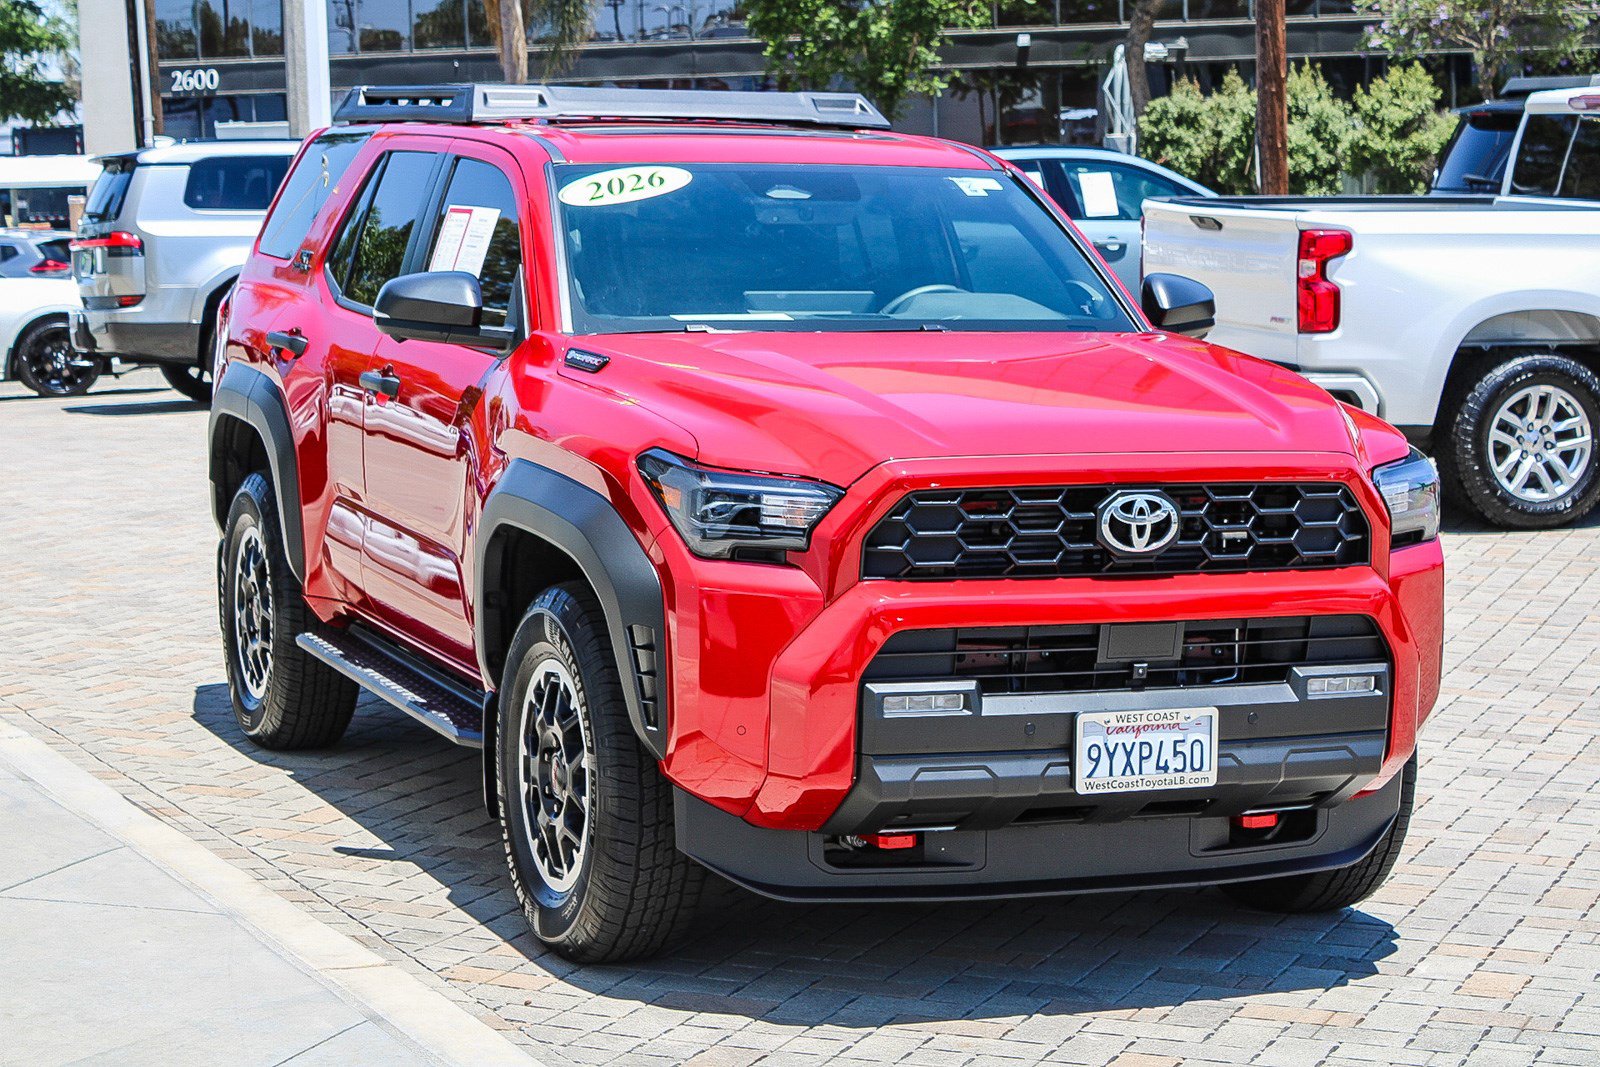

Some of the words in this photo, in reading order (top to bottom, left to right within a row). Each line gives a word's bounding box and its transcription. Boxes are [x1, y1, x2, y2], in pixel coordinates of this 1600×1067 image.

[171, 69, 219, 91] 2600
[588, 171, 665, 201] 2026
[562, 640, 592, 748] MICHELIN
[1115, 713, 1143, 724] WEST
[1146, 711, 1180, 721] COAST
[1087, 739, 1204, 778] 9YXP450
[1084, 776, 1210, 791] WestCoastToyotaLB.com
[499, 801, 525, 905] MICHELIN
